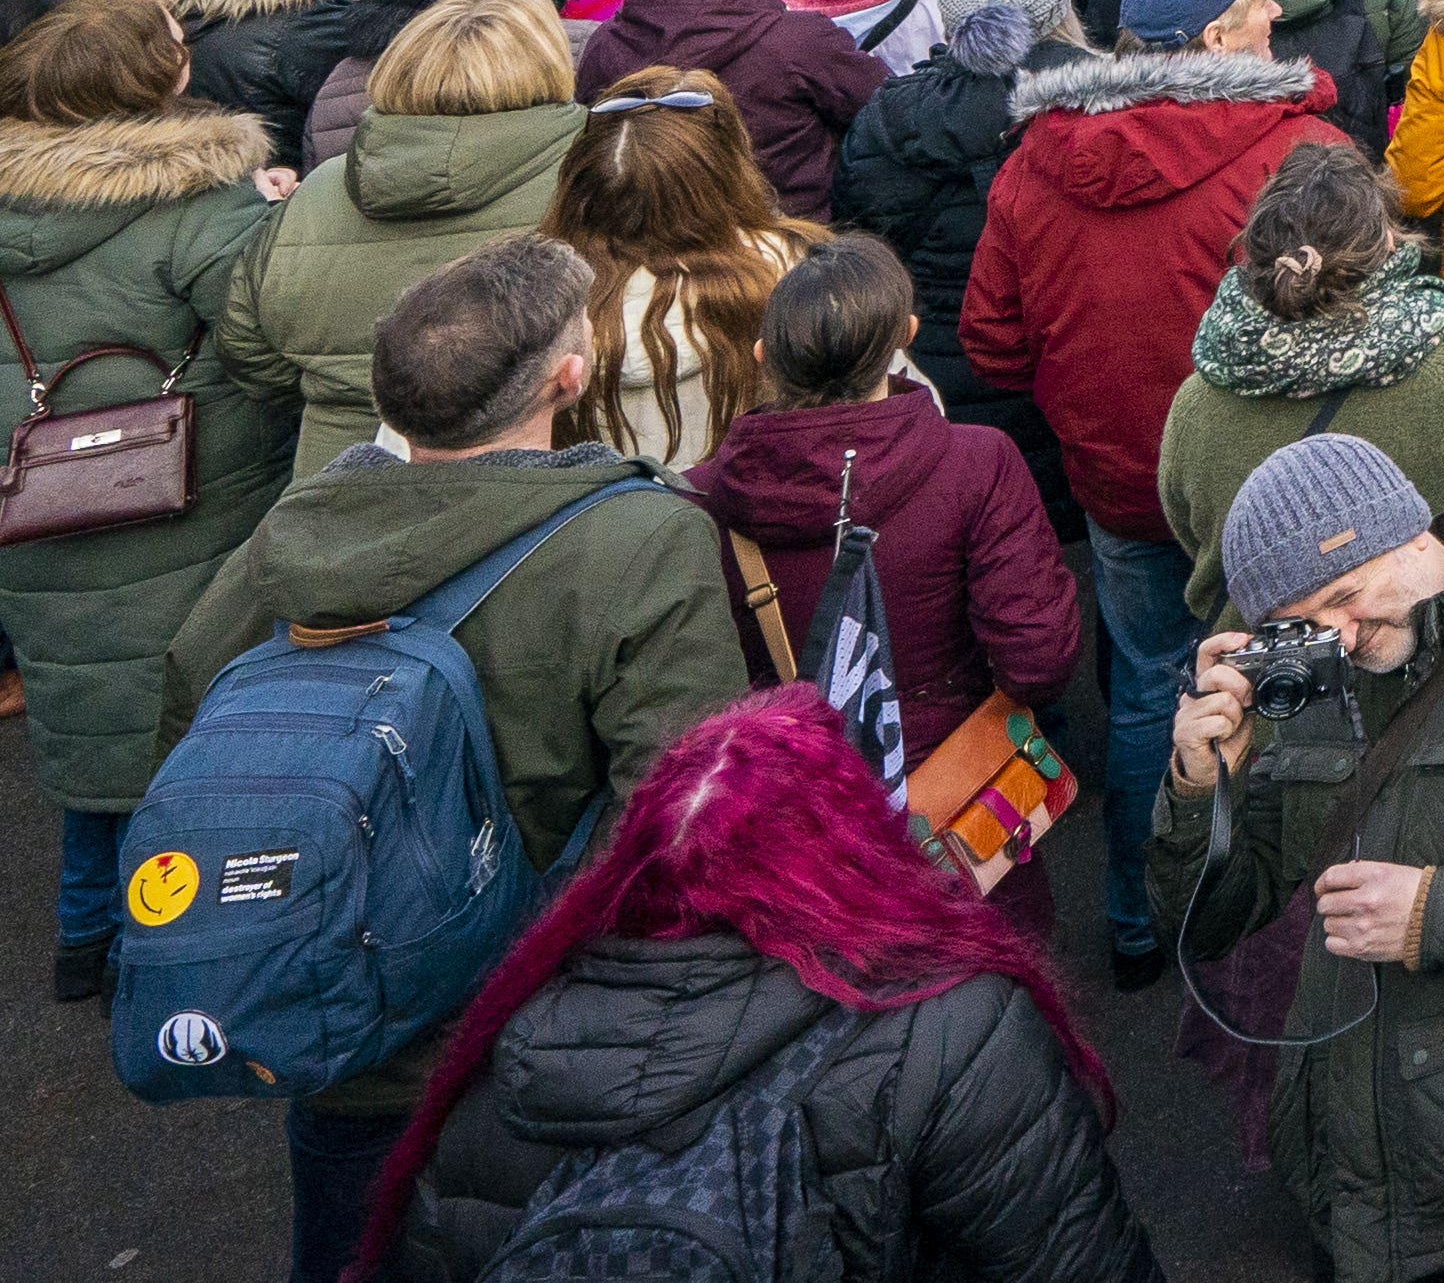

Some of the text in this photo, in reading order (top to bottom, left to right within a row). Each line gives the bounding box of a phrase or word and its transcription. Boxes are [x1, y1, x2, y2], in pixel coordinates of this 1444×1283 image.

[225, 852, 300, 870] Nicola Sturgeon
[221, 879, 274, 894] destroyer of
[220, 889, 282, 904] women's rights
